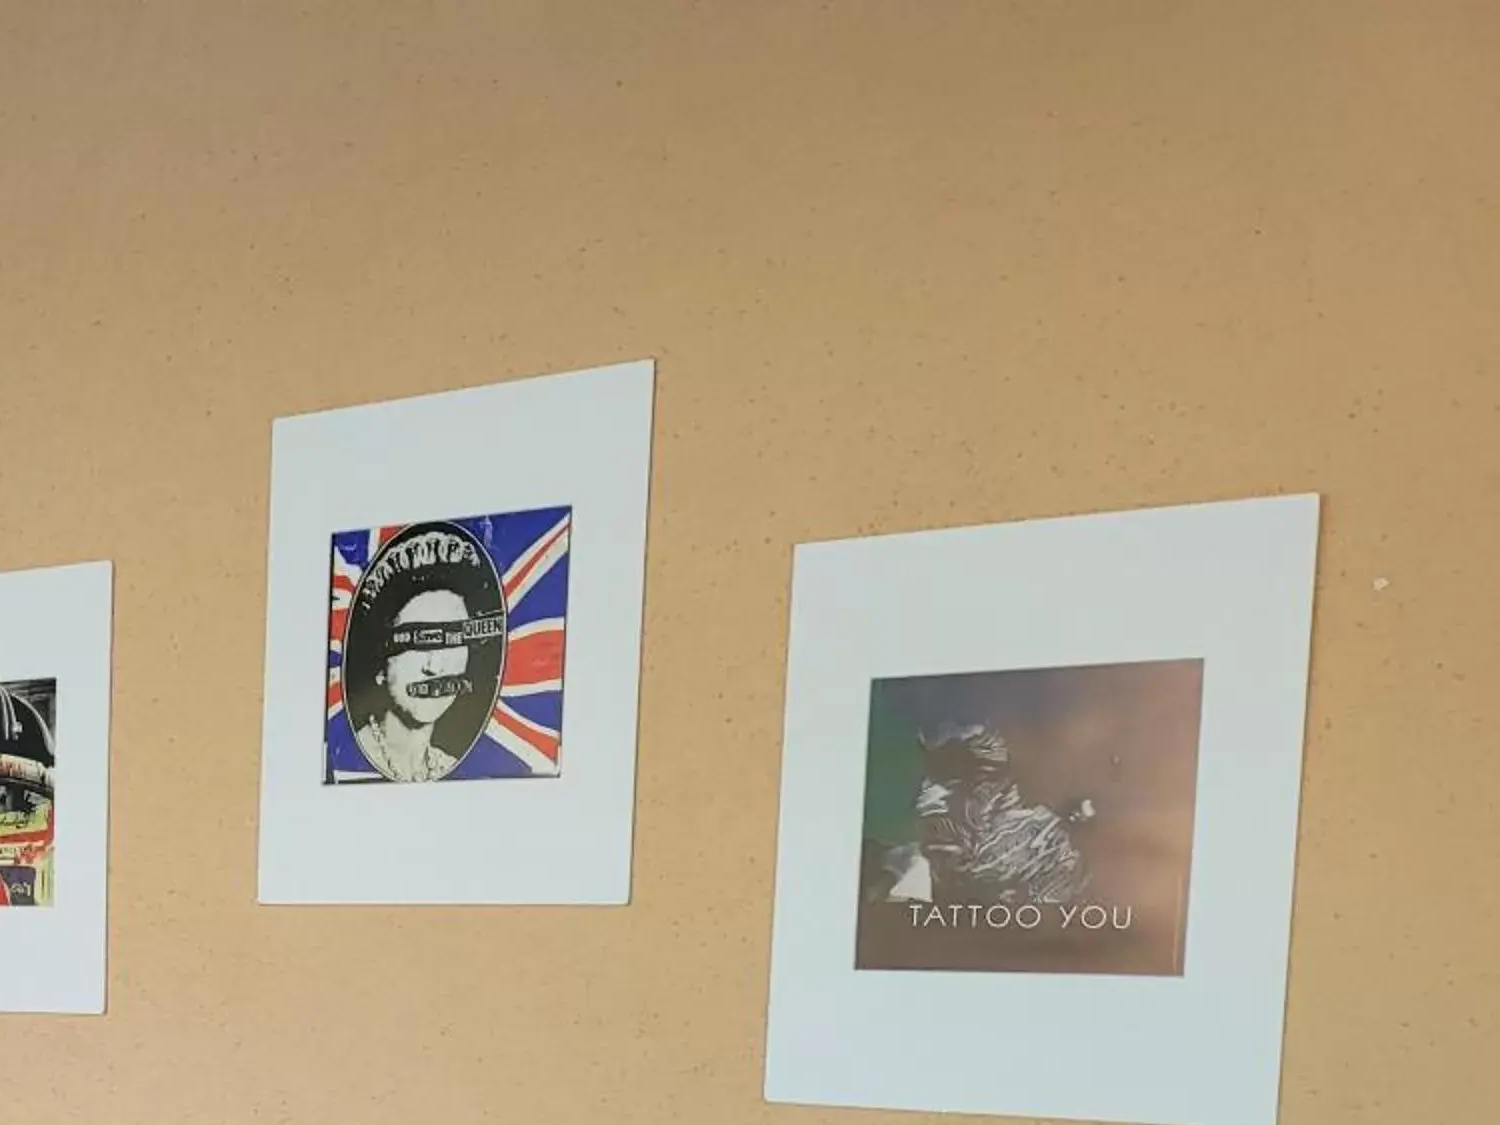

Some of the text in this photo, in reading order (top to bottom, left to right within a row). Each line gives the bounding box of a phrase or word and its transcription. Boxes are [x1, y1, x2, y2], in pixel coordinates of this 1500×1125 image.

[463, 618, 502, 638] QUEEN
[909, 904, 1133, 930] TATTOO YOU
